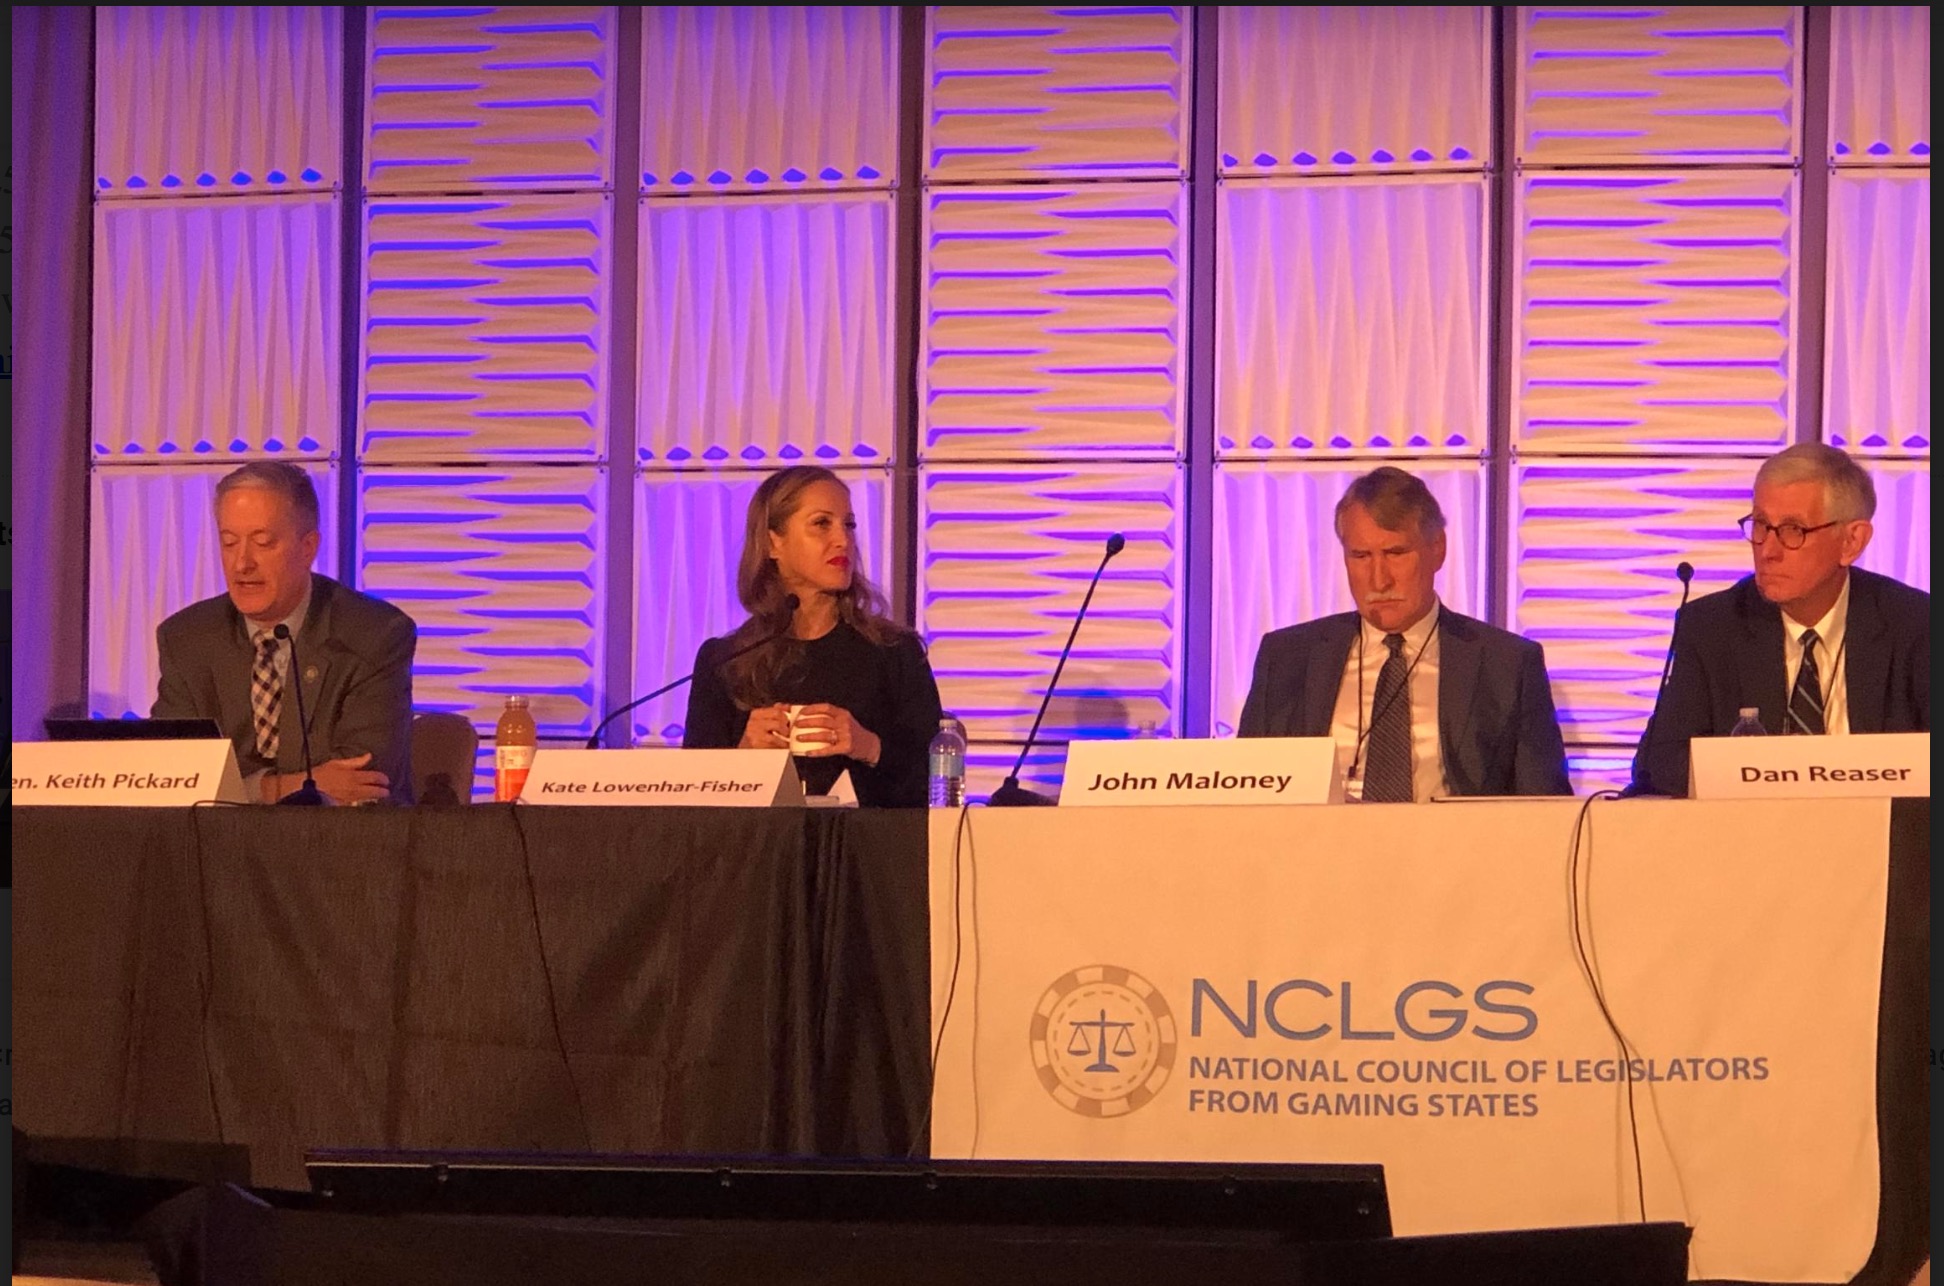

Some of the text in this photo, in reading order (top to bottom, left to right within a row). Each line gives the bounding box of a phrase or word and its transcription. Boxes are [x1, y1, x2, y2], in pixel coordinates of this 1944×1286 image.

[46, 773, 106, 789] Keith
[113, 773, 200, 789] Pickard
[1088, 771, 1292, 793] John Maloney
[1741, 766, 1911, 782] Dan Reaser
[542, 781, 763, 793] Kate Lowenhar-Fisher
[1191, 978, 1539, 1042] NCLGS
[1189, 1056, 1769, 1083] NATIONAL COUNCIL OF LEGISLATORS
[1189, 1089, 1538, 1117] FROM GAMING STATES
